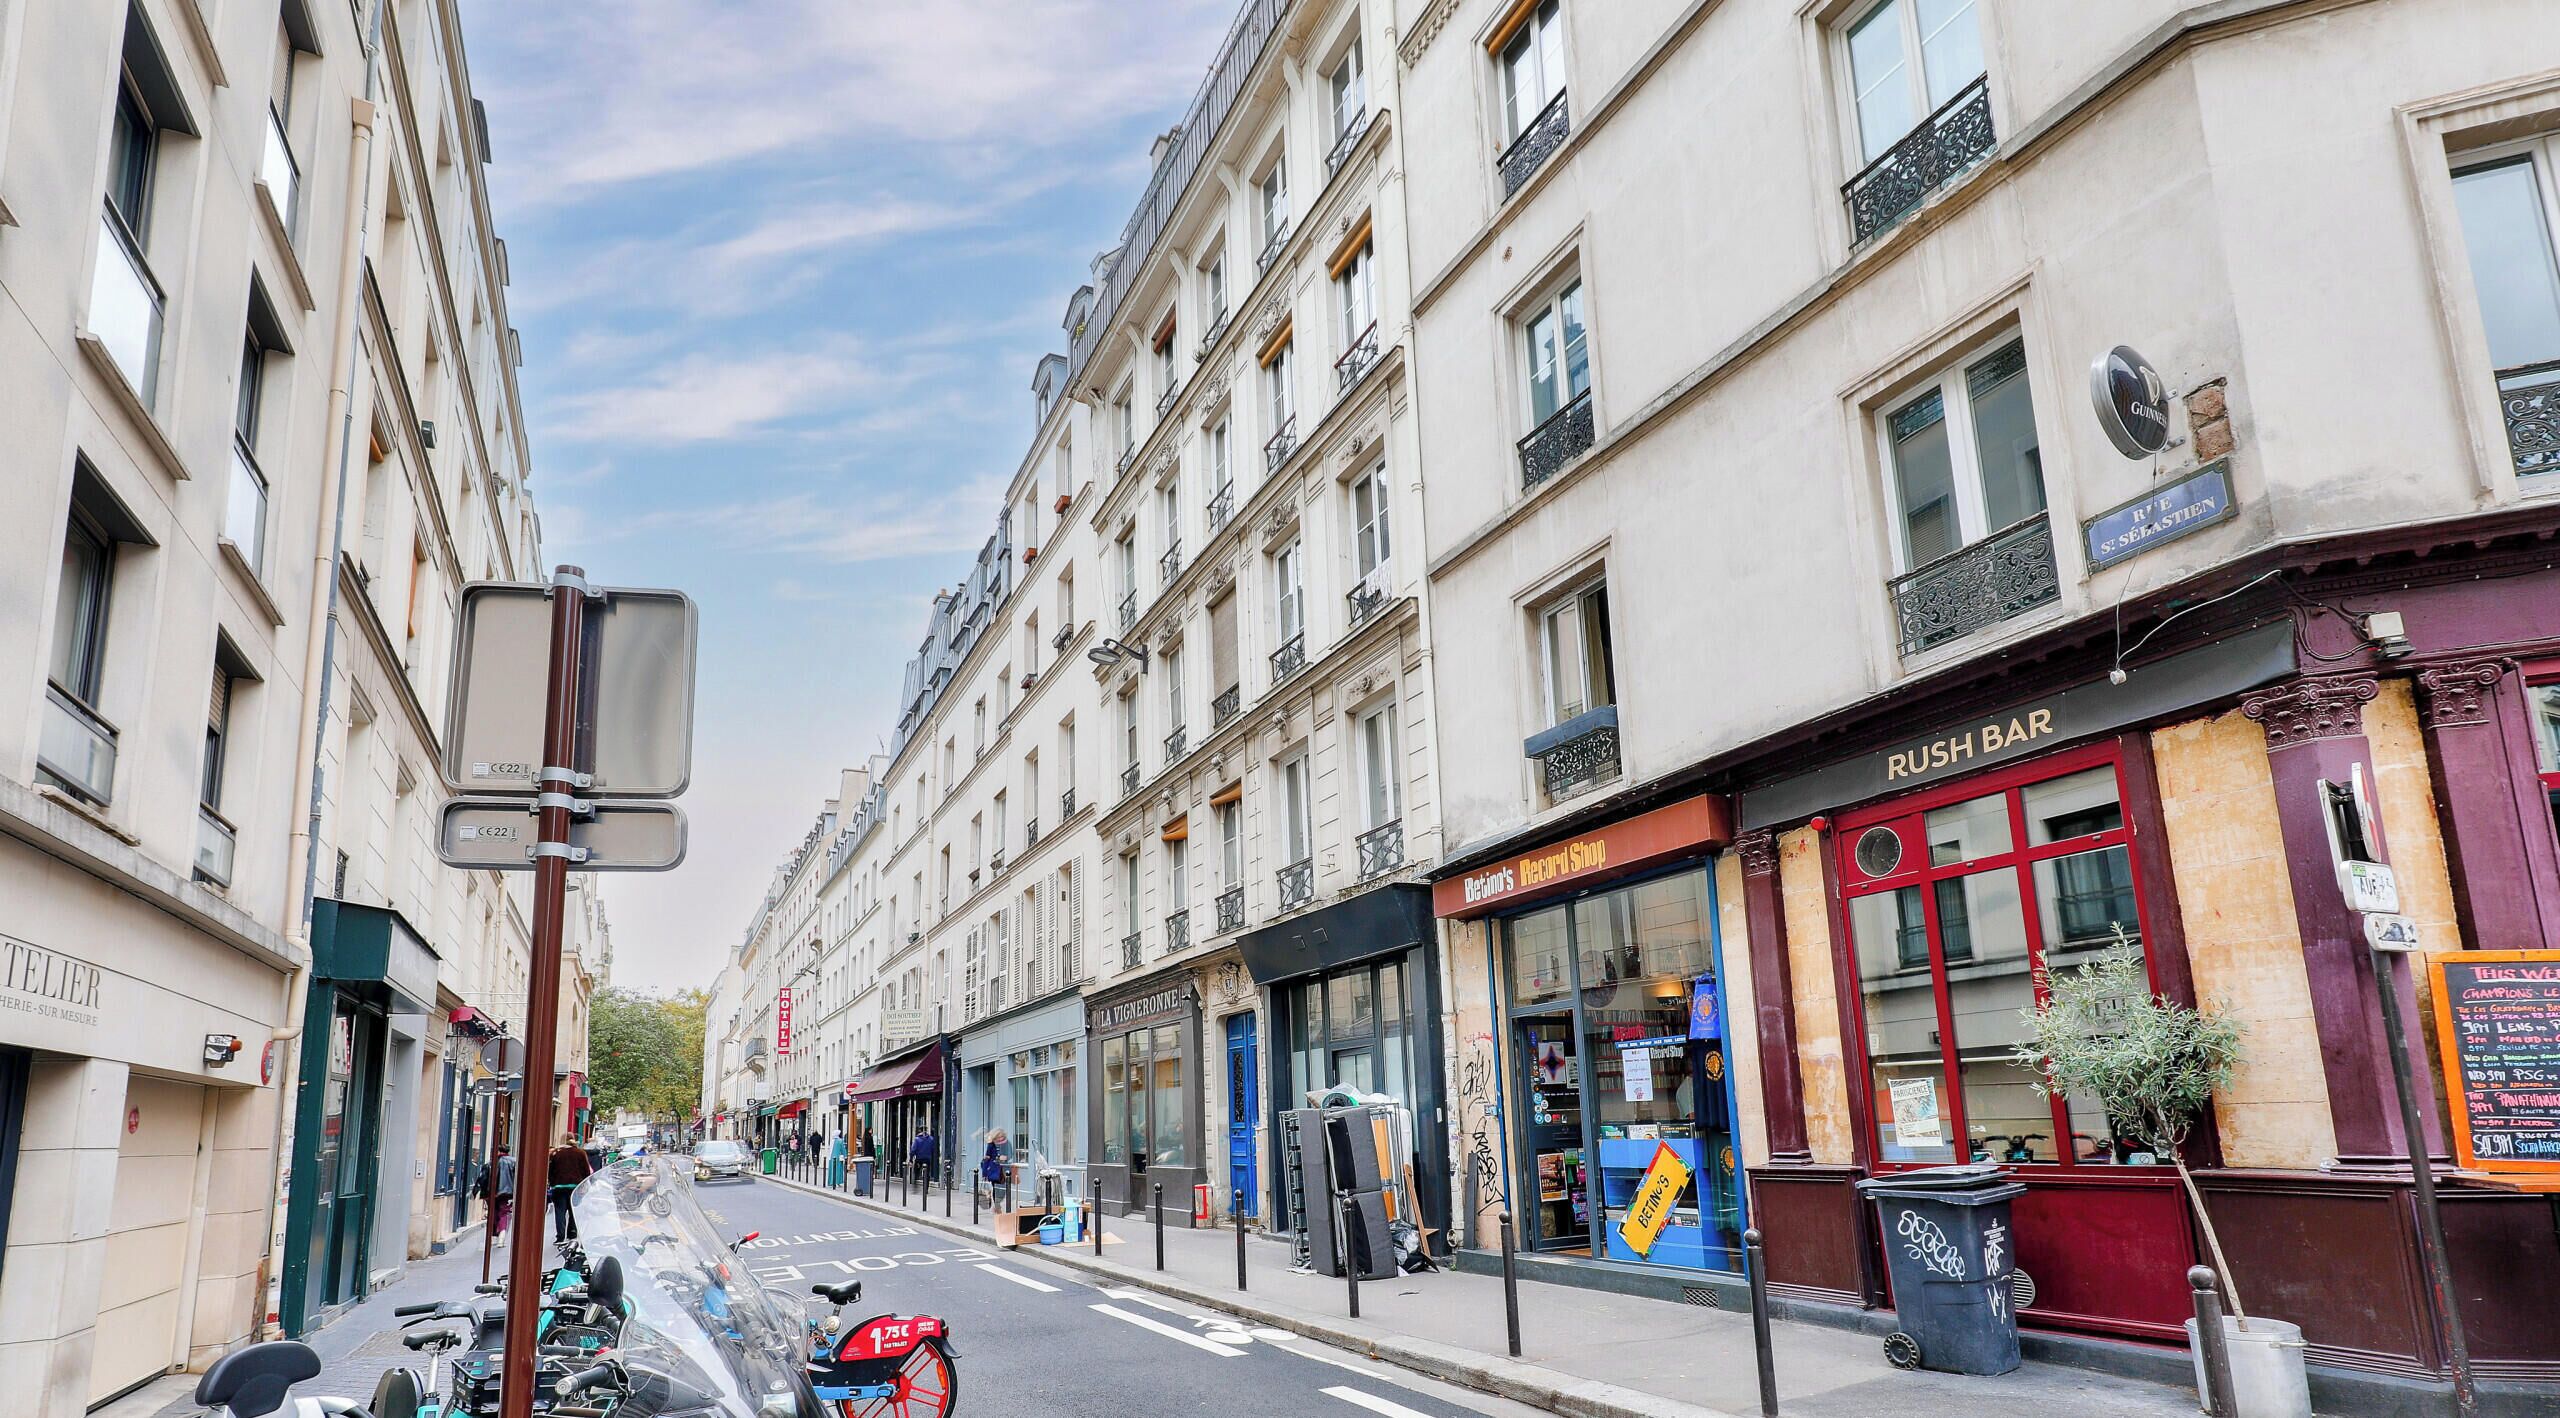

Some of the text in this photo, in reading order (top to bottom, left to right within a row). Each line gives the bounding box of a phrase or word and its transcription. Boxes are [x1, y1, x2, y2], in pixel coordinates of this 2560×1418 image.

[1888, 708, 2053, 780] RUSH BAR
[1464, 839, 1606, 903] Betino's Record Shop
[0, 942, 101, 1010] TELIER
[60, 1008, 98, 1026] MESURE
[780, 990, 790, 1040] HOTEL
[1101, 988, 1178, 1027] LA VIGNERONNE
[2462, 1021, 2489, 1035] 9PM
[2496, 1021, 2534, 1033] LENS
[2467, 1070, 2486, 1081] WED
[2512, 1068, 2545, 1080] PSG
[2472, 1134, 2492, 1157] SAT
[741, 1226, 921, 1250] ATTENTION
[750, 1247, 1001, 1284] ECOLE
